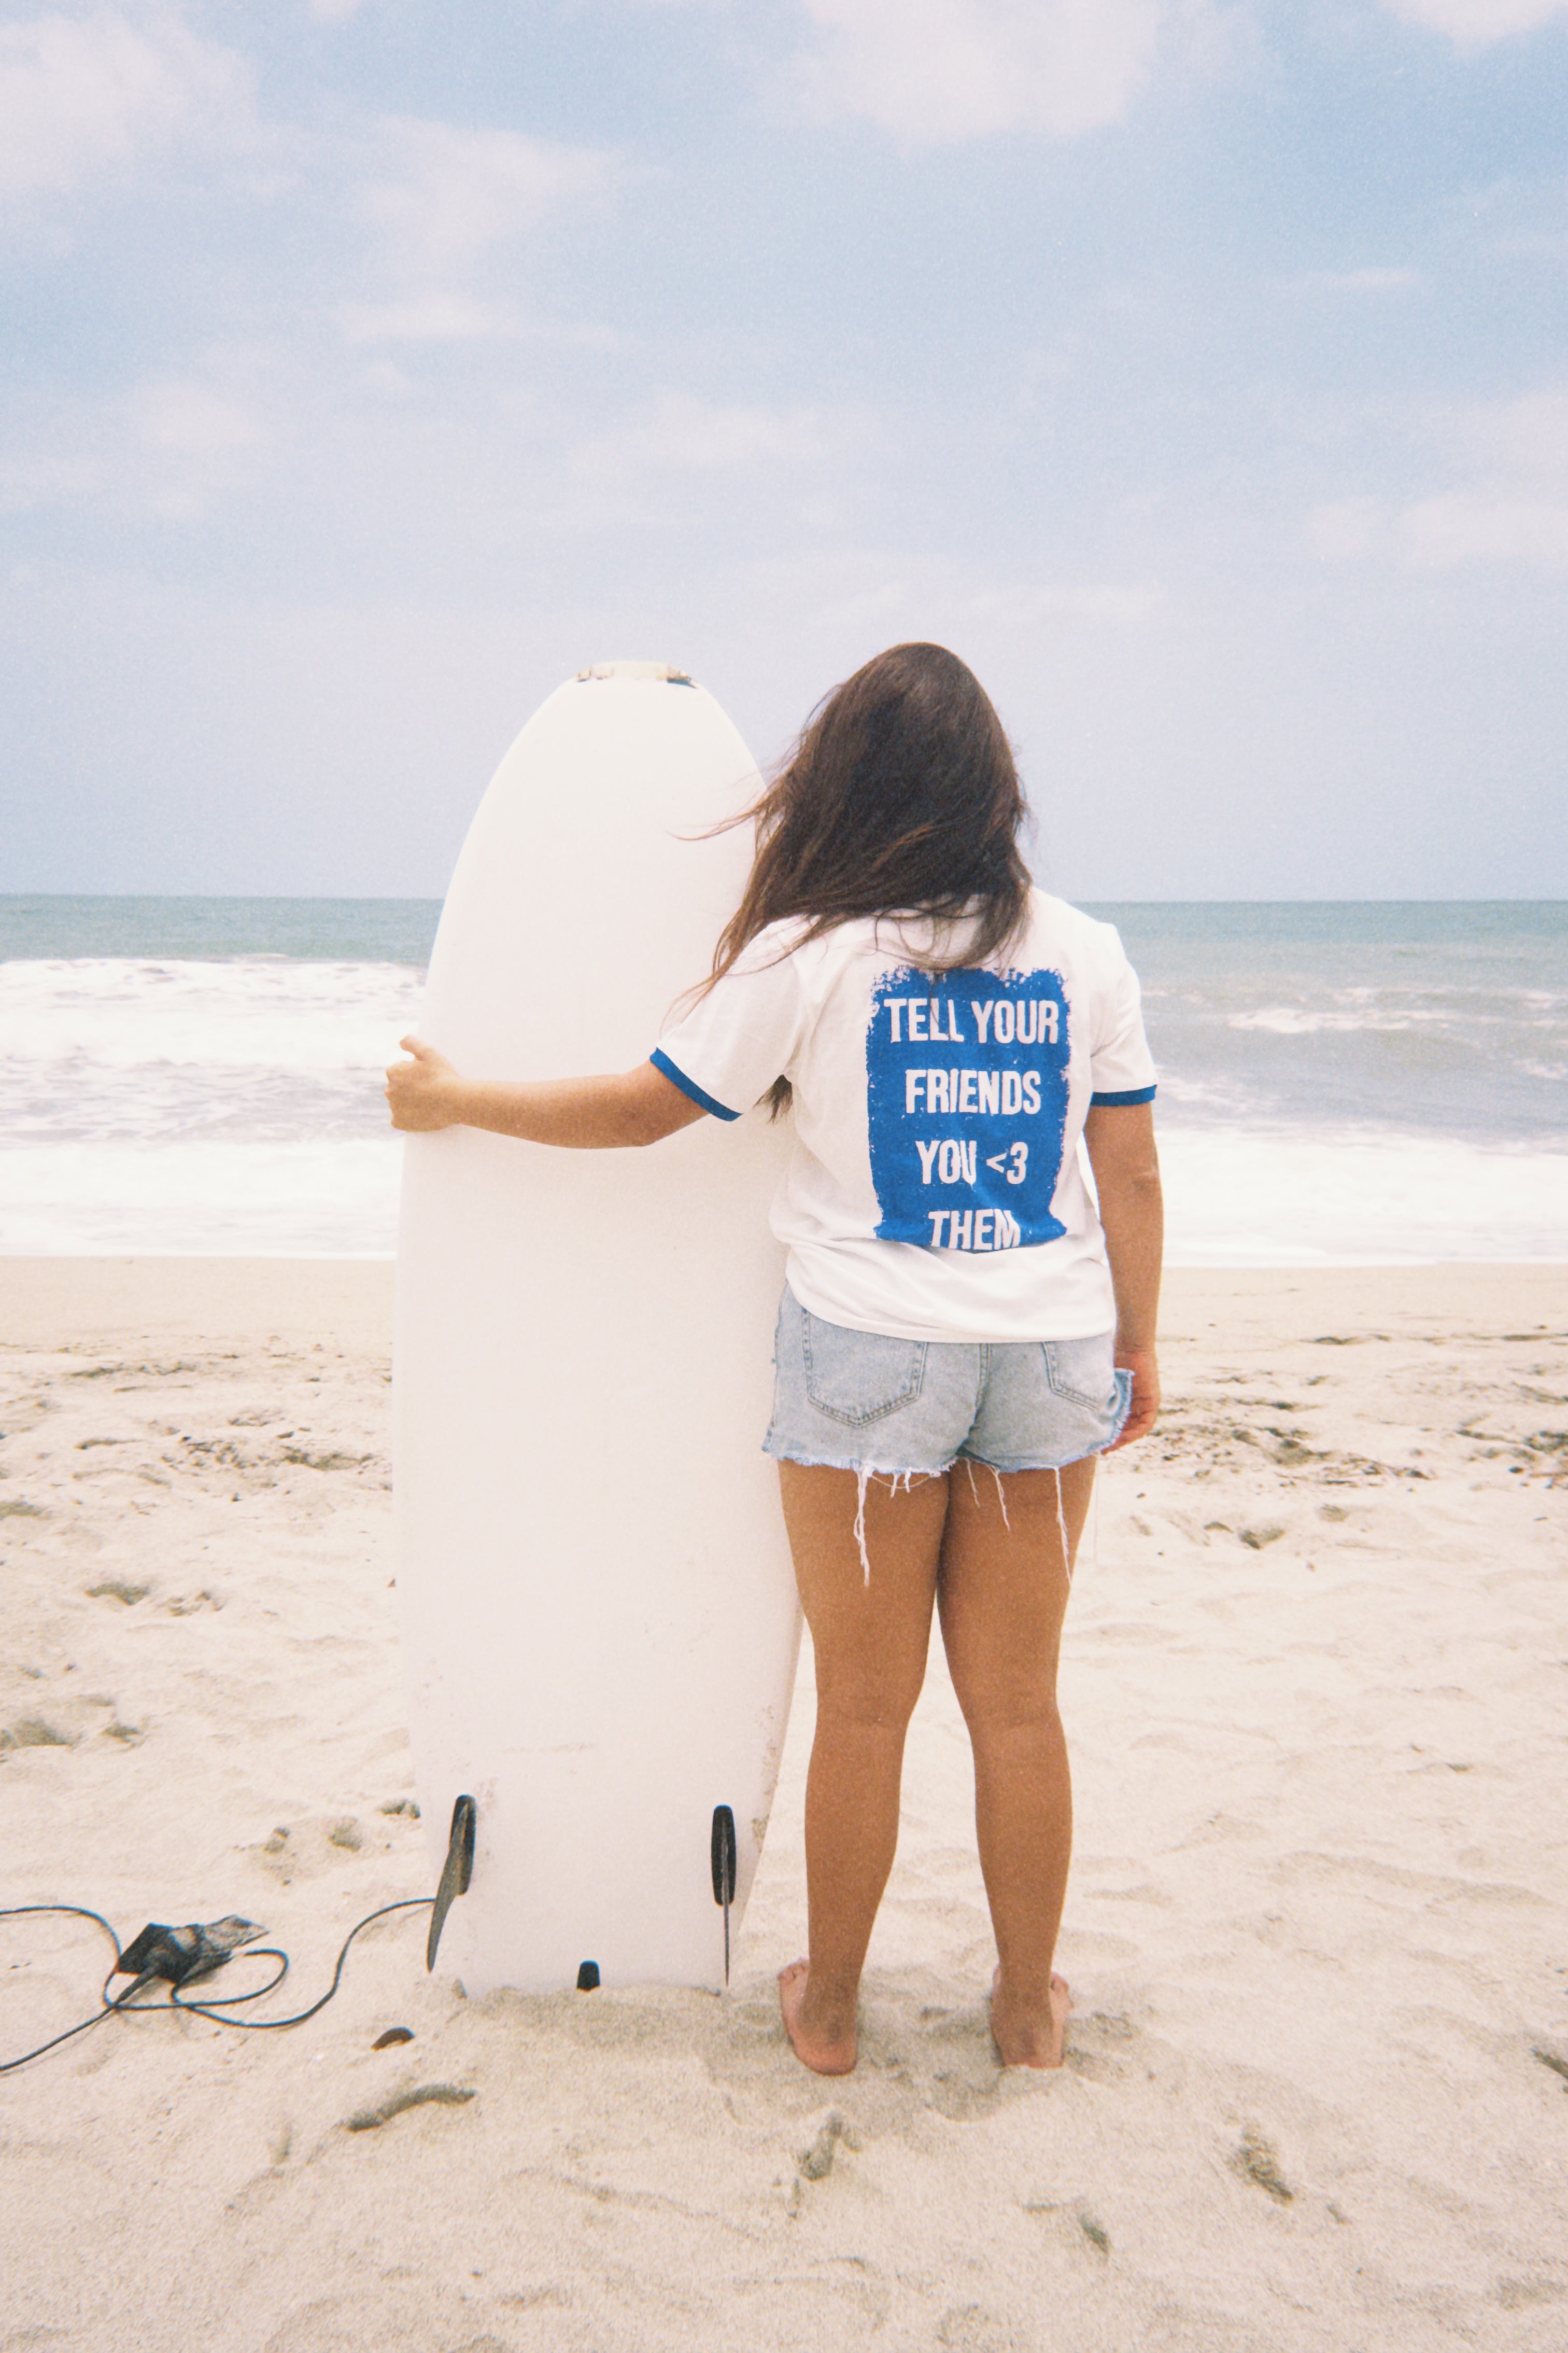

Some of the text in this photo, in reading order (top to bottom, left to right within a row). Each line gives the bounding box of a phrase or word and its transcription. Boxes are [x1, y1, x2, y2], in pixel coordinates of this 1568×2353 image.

[884, 998, 1059, 1044] TELL YOUR
[905, 1068, 1041, 1115] FRIENDS
[915, 1139, 977, 1186] YOU
[928, 1209, 1021, 1250] THEM
